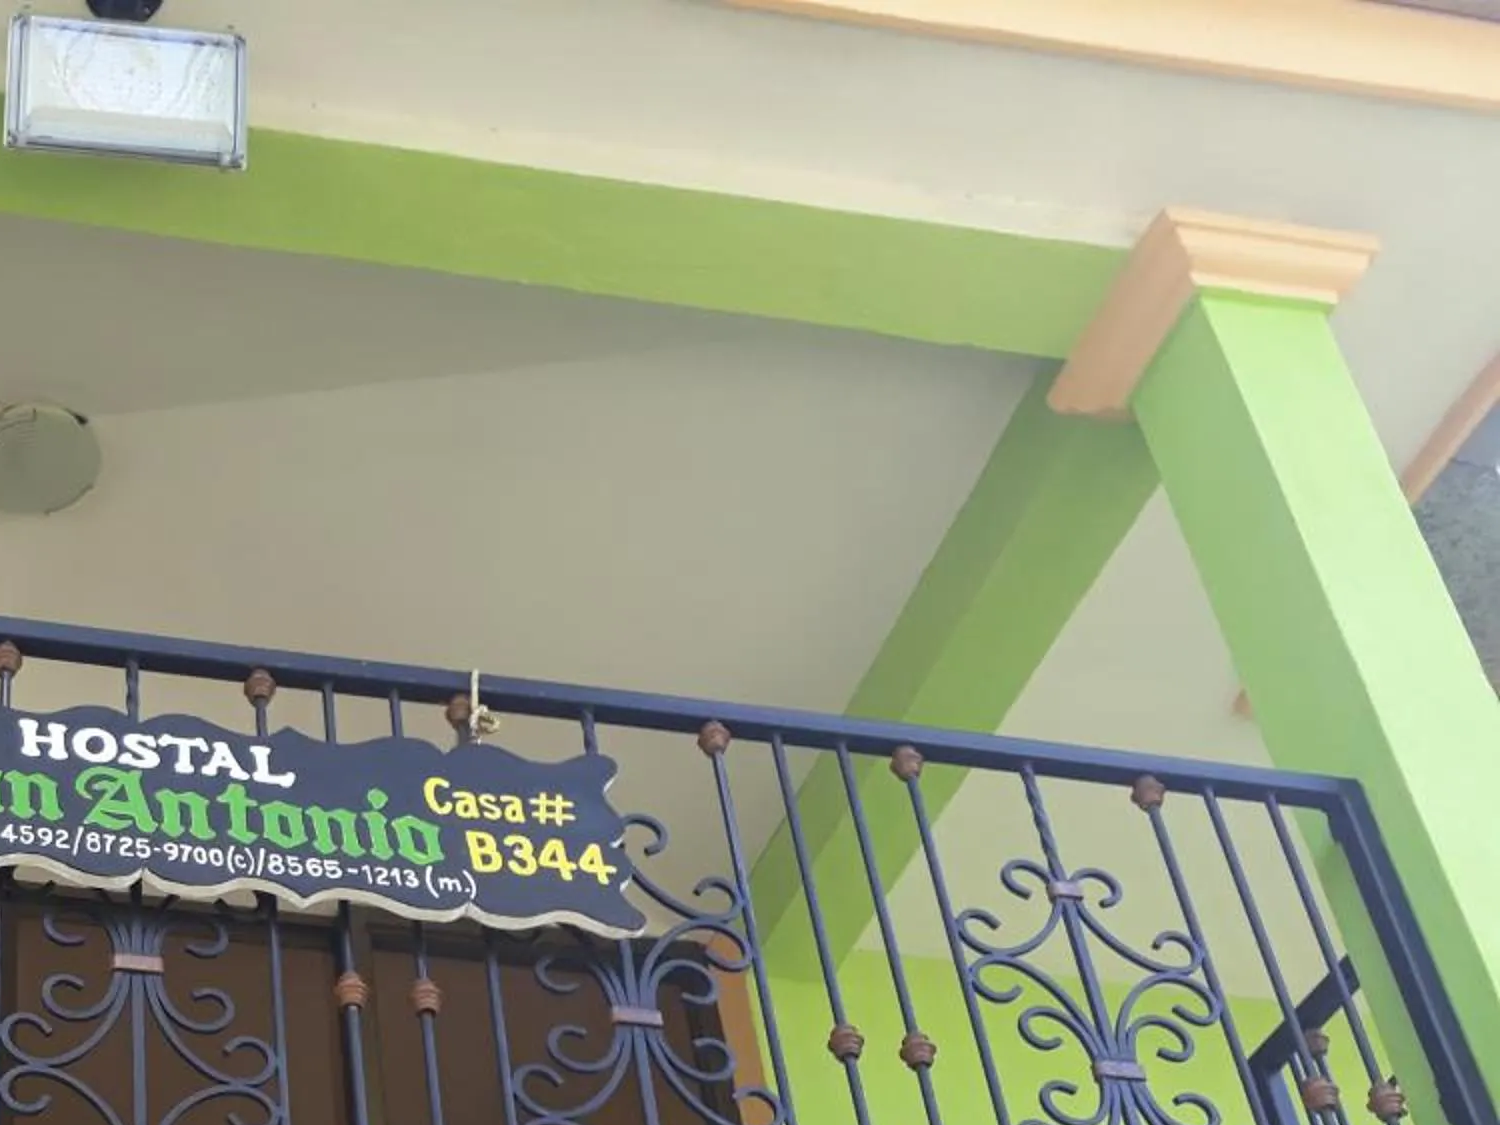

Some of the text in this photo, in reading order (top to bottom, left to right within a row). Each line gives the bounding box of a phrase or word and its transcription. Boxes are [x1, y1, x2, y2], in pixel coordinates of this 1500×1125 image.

[17, 717, 297, 789] HOSTAL
[75, 765, 446, 867] Antonio
[464, 829, 619, 886] B344
